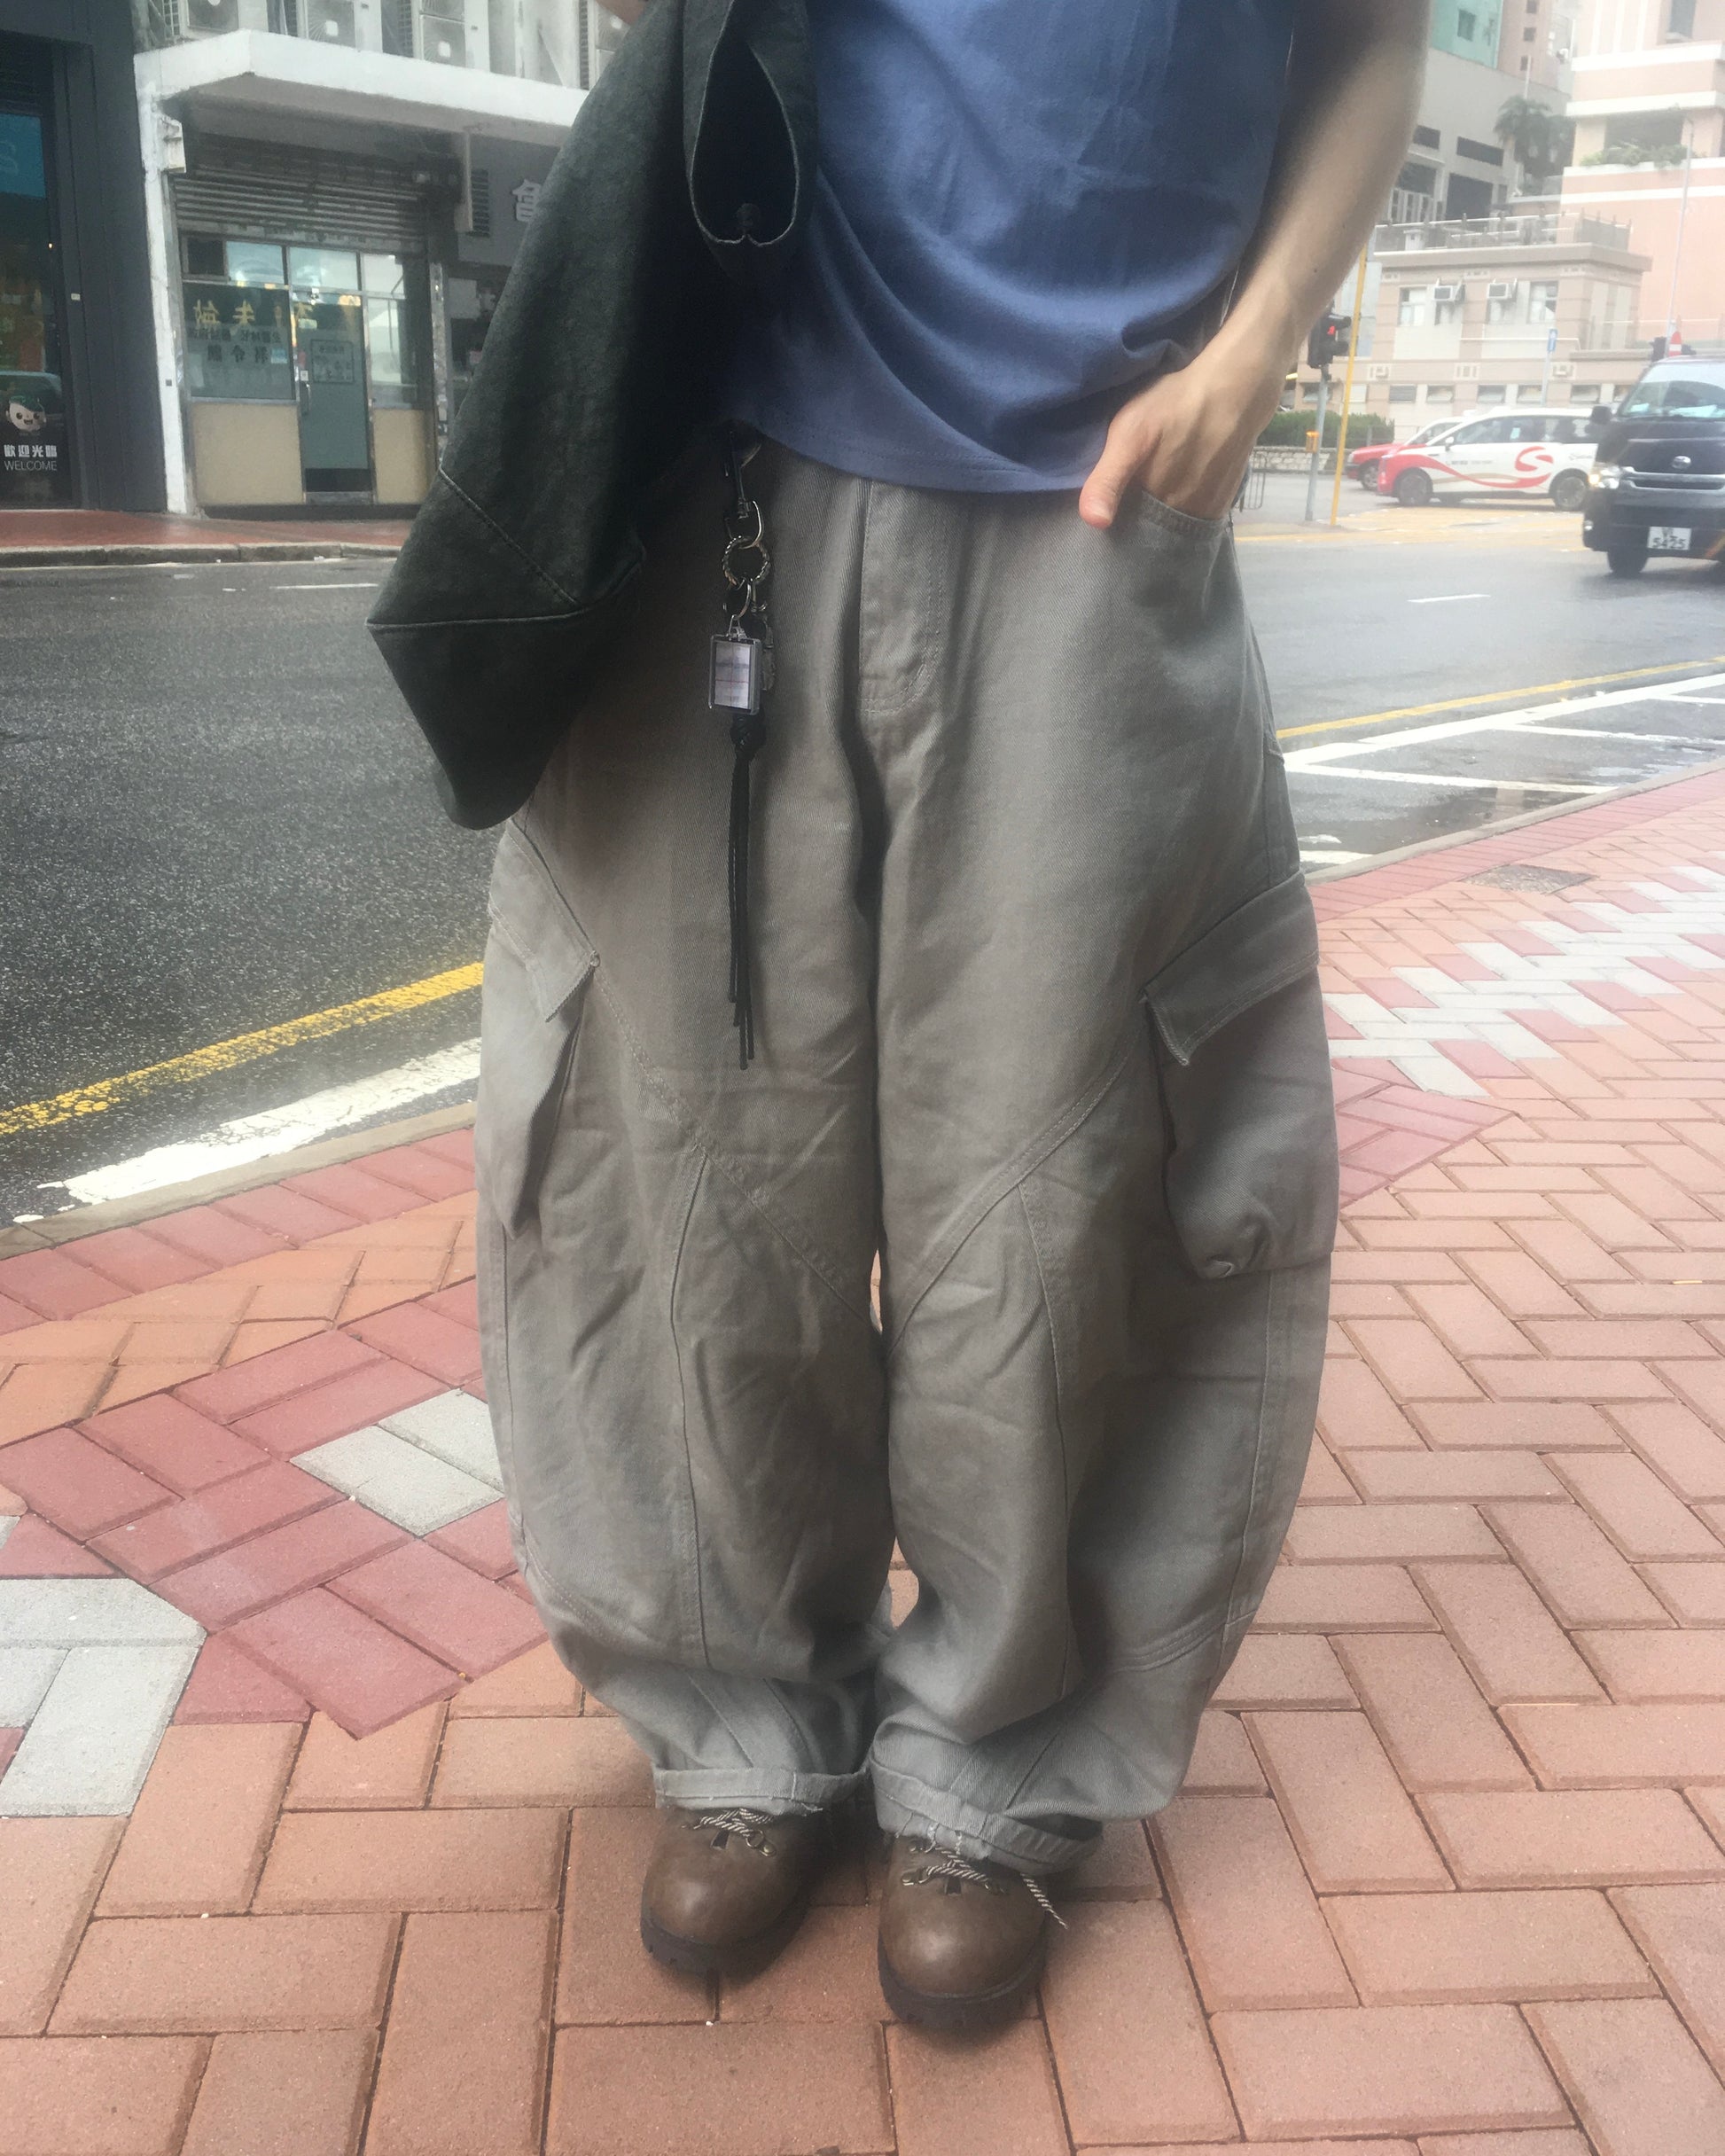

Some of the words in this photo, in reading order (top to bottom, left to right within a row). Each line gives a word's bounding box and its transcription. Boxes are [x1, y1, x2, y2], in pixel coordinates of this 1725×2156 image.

[4, 444, 58, 457] 歡迎光臨
[4, 460, 58, 471] WELCOME
